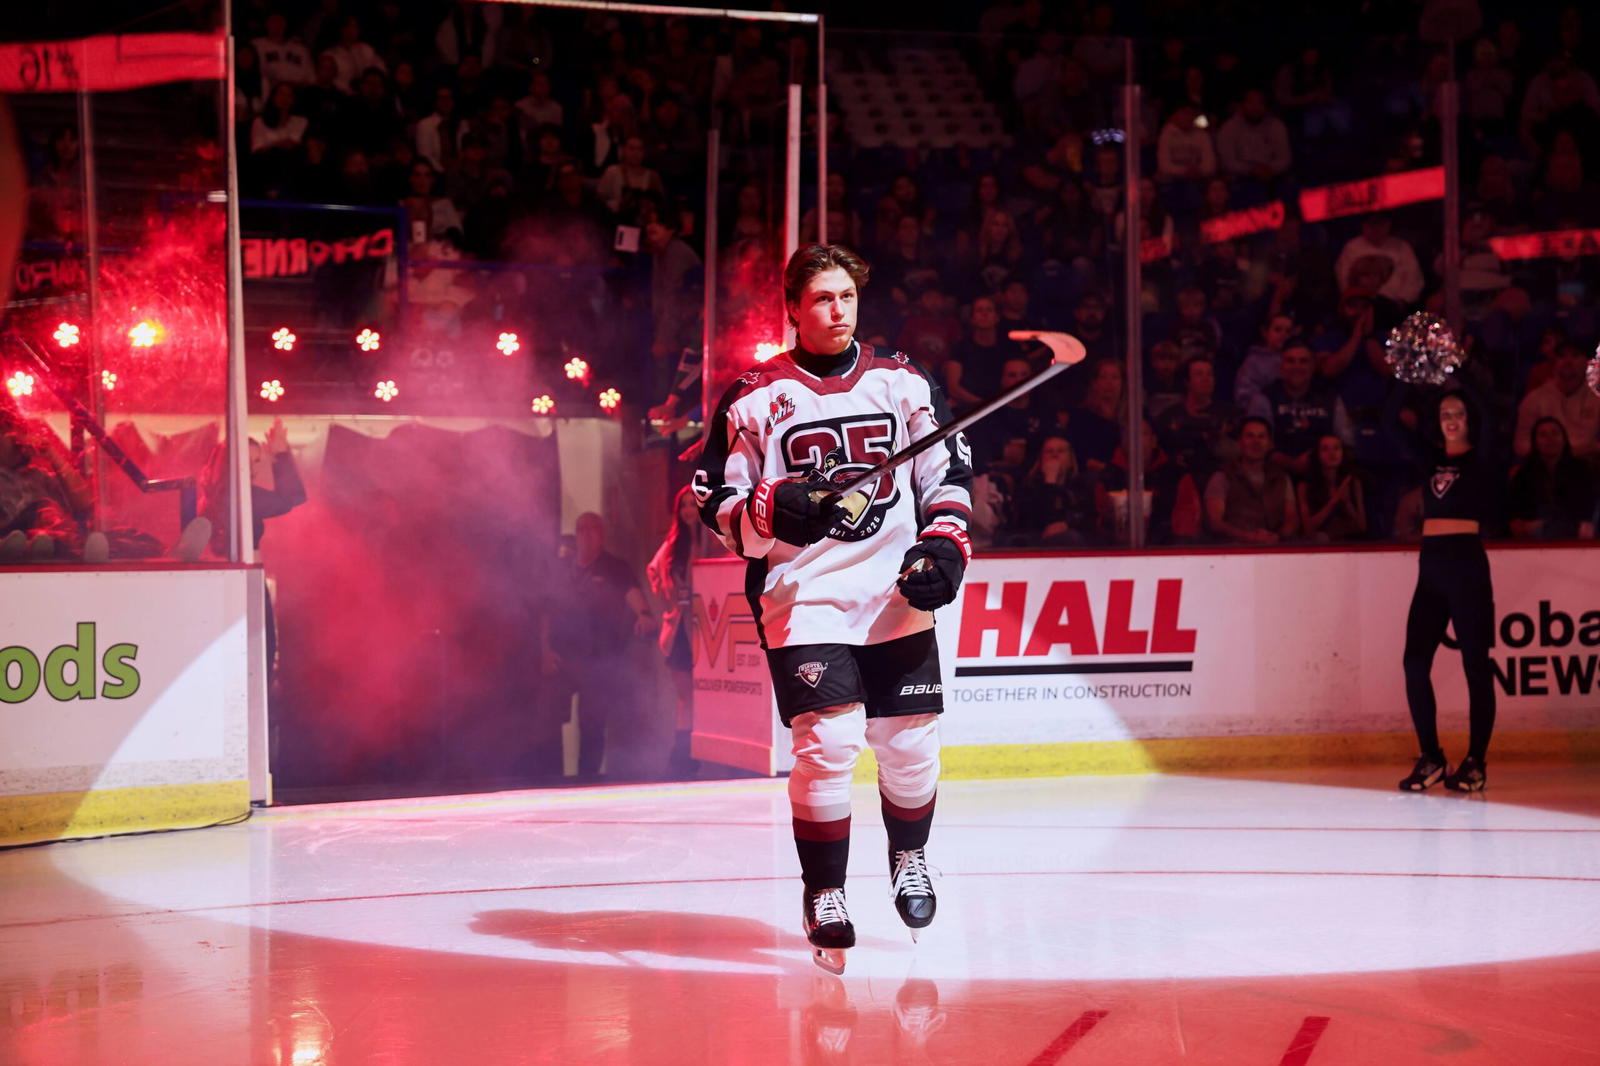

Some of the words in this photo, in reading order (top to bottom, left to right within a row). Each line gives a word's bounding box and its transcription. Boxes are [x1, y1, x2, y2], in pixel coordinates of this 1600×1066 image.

[786, 418, 898, 507] 25
[859, 515, 881, 537] 2026
[956, 578, 1198, 658] HALL
[952, 686, 1037, 703] TOGETHER
[1041, 685, 1059, 701] IN
[1063, 682, 1193, 701] CONSTRUCTION
[1490, 655, 1600, 698] NEW
